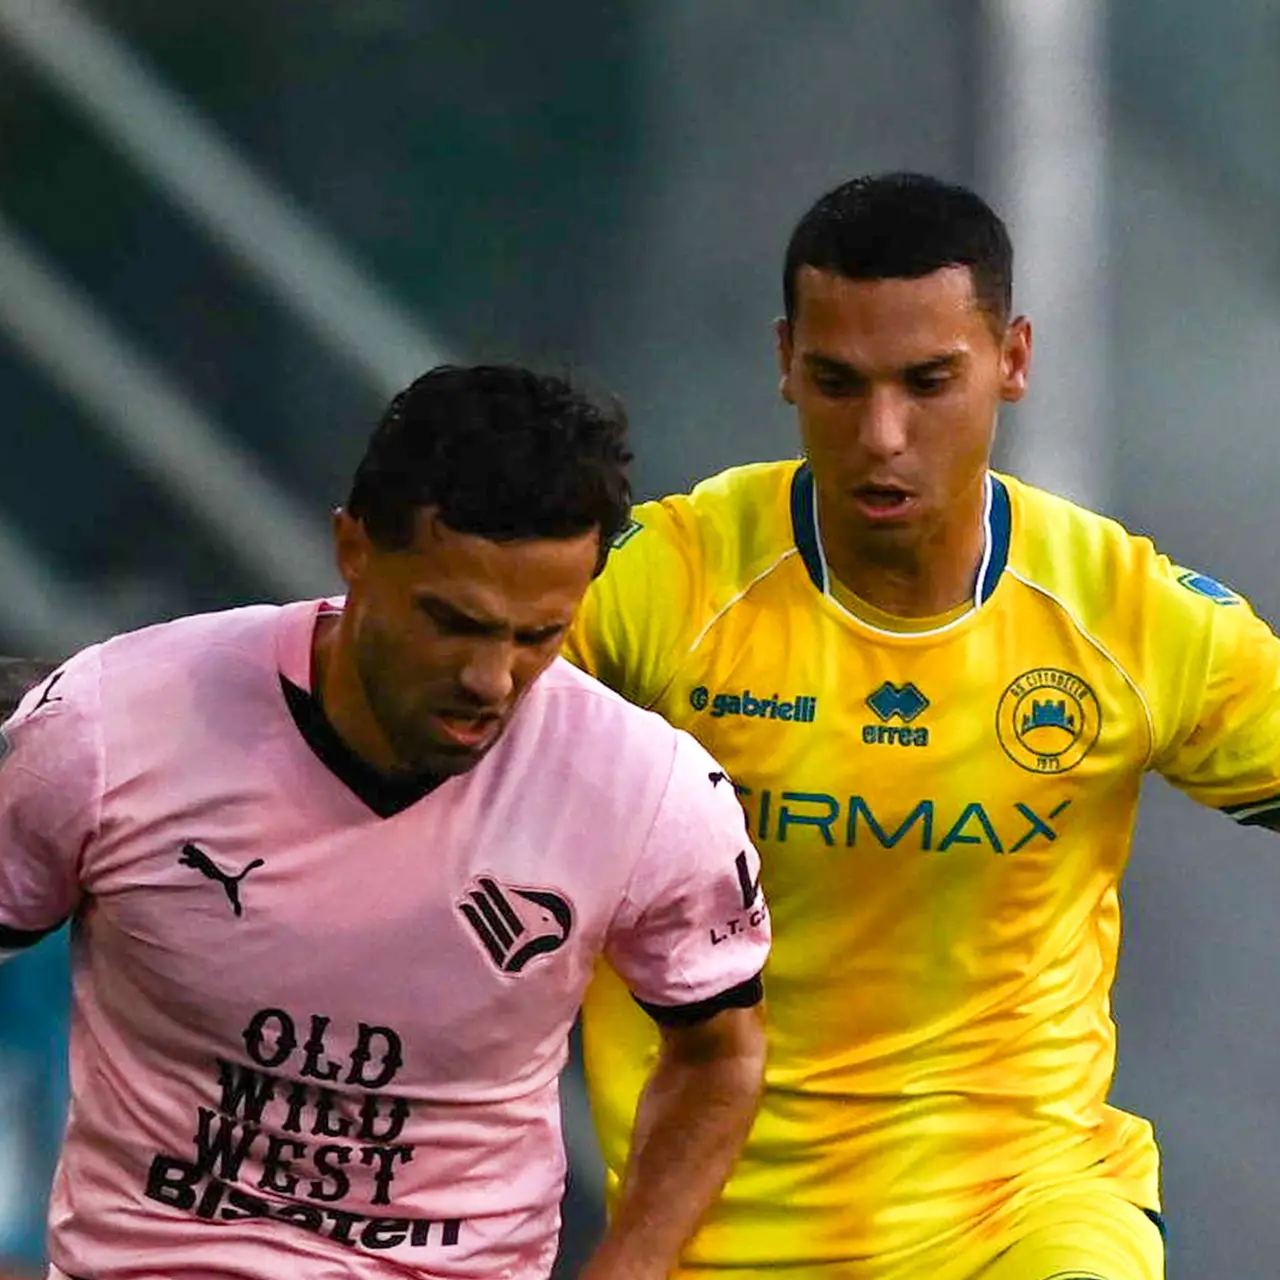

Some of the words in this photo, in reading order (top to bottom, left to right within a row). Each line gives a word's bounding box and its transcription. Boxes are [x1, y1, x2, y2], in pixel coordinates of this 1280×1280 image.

[710, 690, 817, 722] gabrielli
[736, 784, 1072, 854] IRMAX
[243, 1008, 403, 1089] OLD
[216, 1057, 411, 1143] WILD
[193, 1106, 415, 1205] WEST
